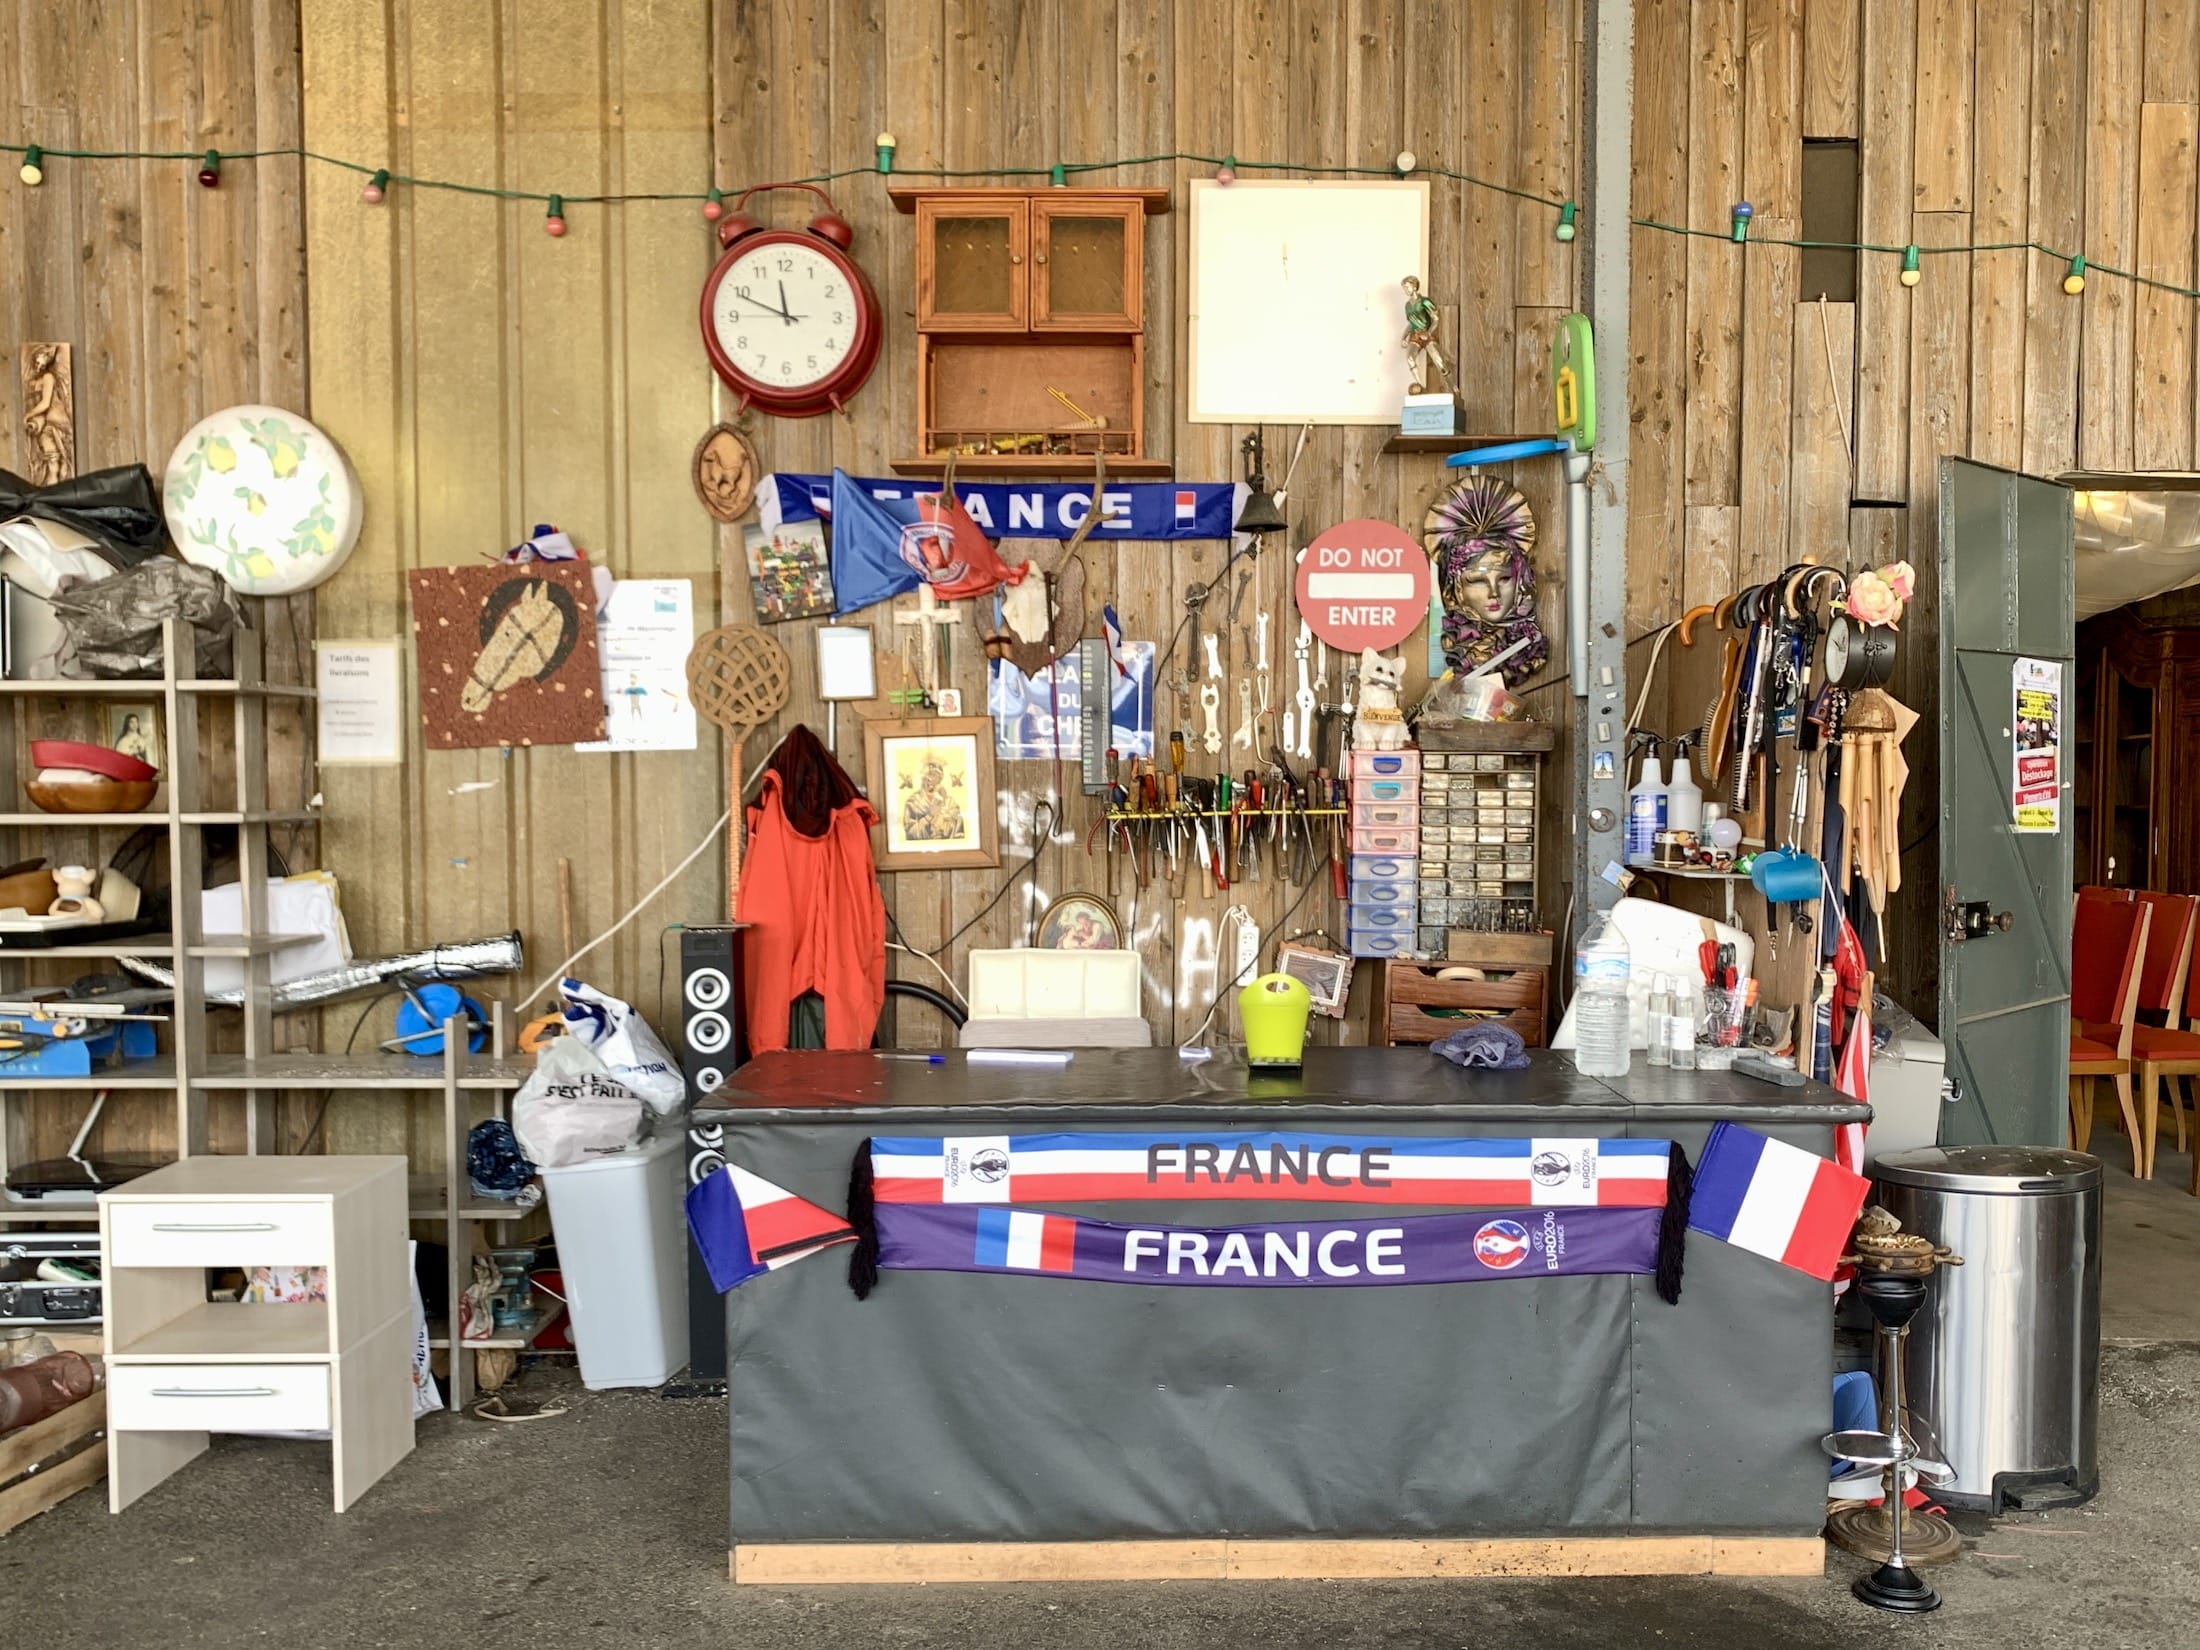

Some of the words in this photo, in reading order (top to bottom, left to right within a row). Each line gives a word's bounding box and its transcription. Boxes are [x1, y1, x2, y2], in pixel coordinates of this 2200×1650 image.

[777, 259, 793, 272] 12
[753, 266, 767, 279] 11
[807, 267, 814, 279] 1
[734, 285, 750, 298] 10
[824, 285, 834, 298] 2
[728, 311, 739, 323] 9
[832, 311, 843, 324] 3
[737, 336, 748, 349] 8
[824, 337, 835, 350] 4
[756, 354, 767, 368] 7
[781, 361, 792, 374] 6
[807, 355, 817, 368] 5
[873, 489, 1132, 529] ANCE
[1319, 547, 1351, 567] DO
[1361, 547, 1404, 567] NOT
[1328, 606, 1396, 626] ENTER
[1147, 1142, 1392, 1188] FRANCE
[1582, 1147, 1591, 1189] EURO2016
[1543, 1210, 1559, 1270] EURO2016
[1557, 1224, 1565, 1255] FRANCE
[1123, 1227, 1406, 1278] FRANCE
